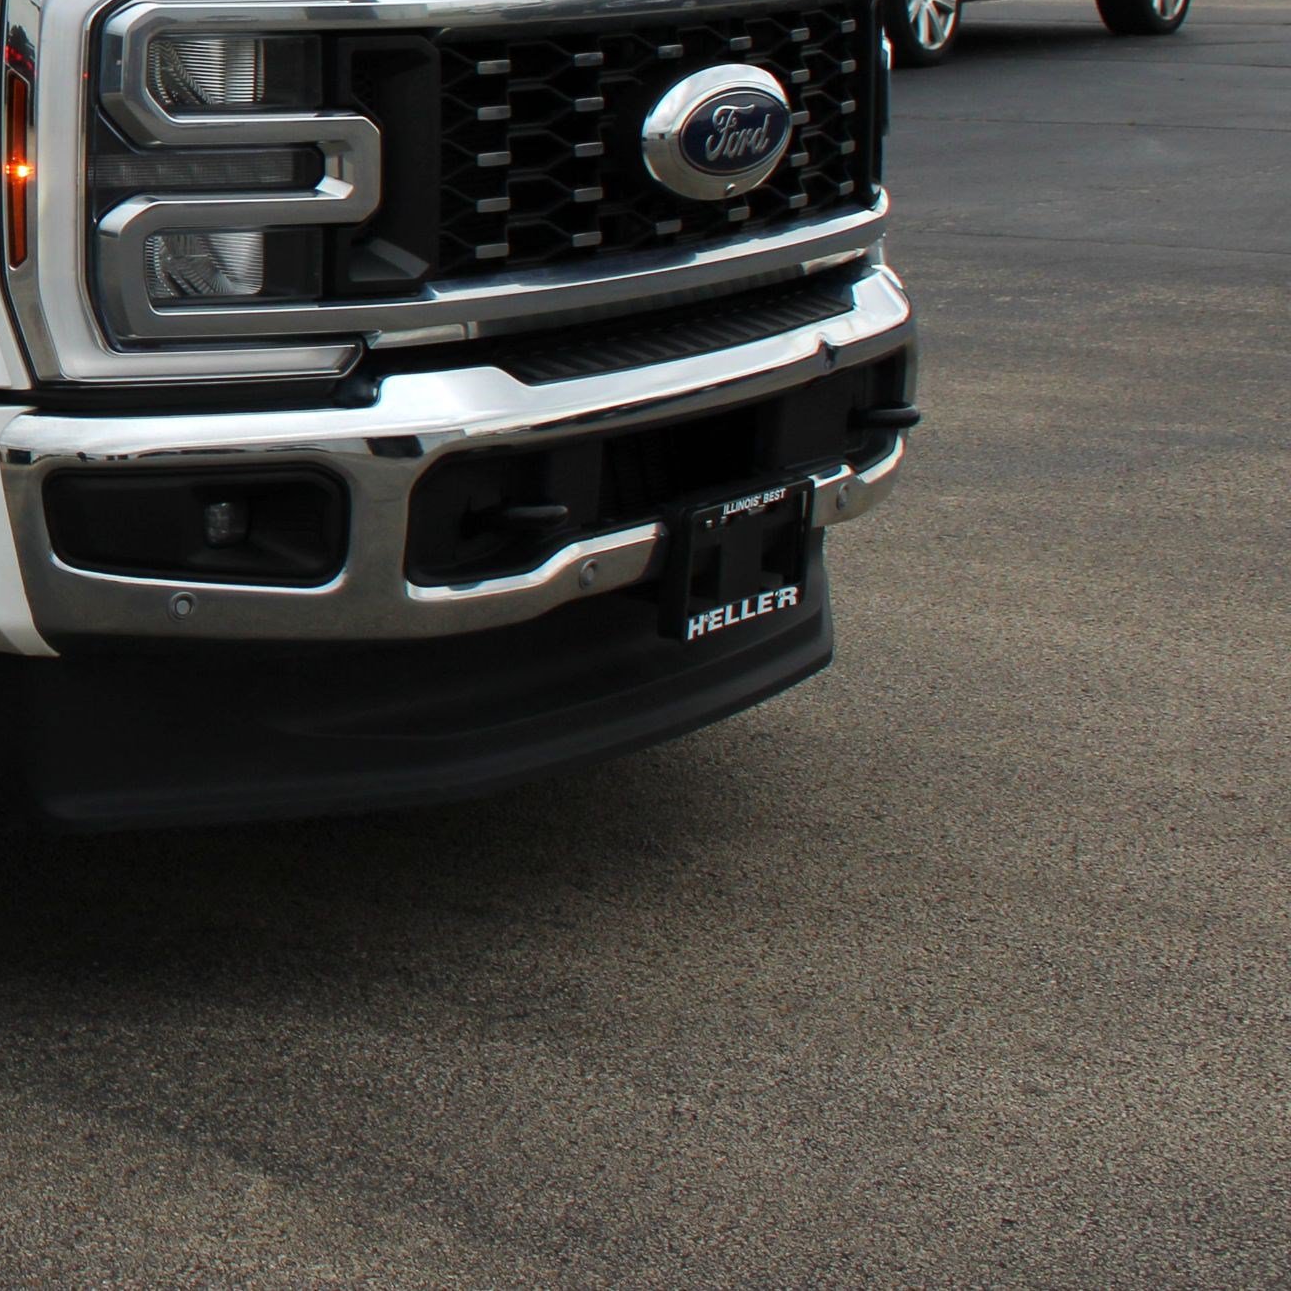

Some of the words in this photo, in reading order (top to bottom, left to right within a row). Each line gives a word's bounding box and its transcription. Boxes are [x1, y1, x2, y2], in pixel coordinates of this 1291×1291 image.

[705, 104, 771, 161] Ford
[723, 496, 762, 514] ILLINOIS'
[763, 488, 786, 504] BEST
[687, 586, 798, 640] HELLER
